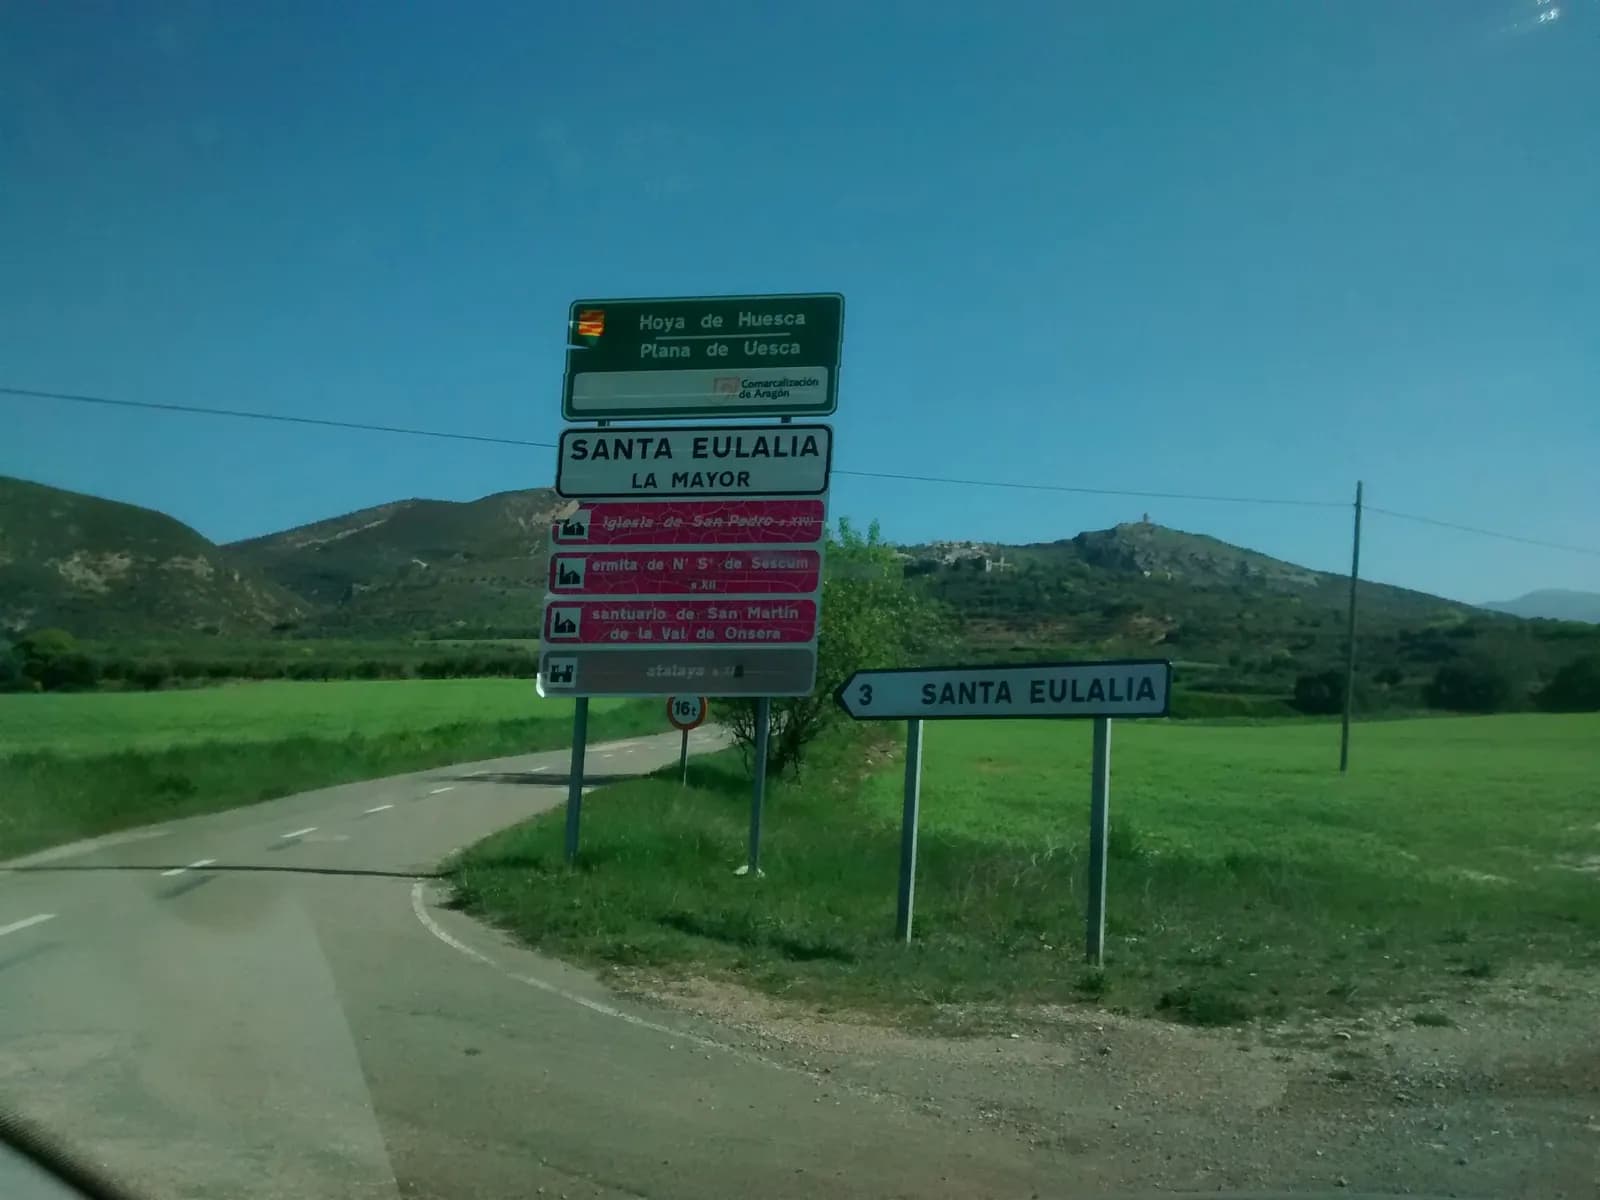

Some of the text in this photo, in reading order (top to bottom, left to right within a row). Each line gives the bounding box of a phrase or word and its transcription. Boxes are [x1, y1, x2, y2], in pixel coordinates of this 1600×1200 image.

[640, 311, 806, 332] Hoya de Huesca
[641, 341, 800, 358] Plana de Uesca
[741, 377, 819, 389] Comarcalización
[739, 389, 790, 400] de Aragón
[570, 435, 819, 461] SANTA EULALIA
[631, 471, 750, 489] LA MAYOR
[663, 515, 682, 528] de
[693, 515, 724, 527] San
[728, 514, 774, 527] Pedro
[592, 559, 637, 571] ermita
[647, 558, 664, 570] de
[725, 558, 742, 569] de
[592, 607, 666, 621] santuario
[676, 607, 694, 620] de
[707, 607, 737, 620] San
[610, 627, 781, 640] de la Val de Onsera
[859, 677, 1156, 706] 3 SANTA EULALIA
